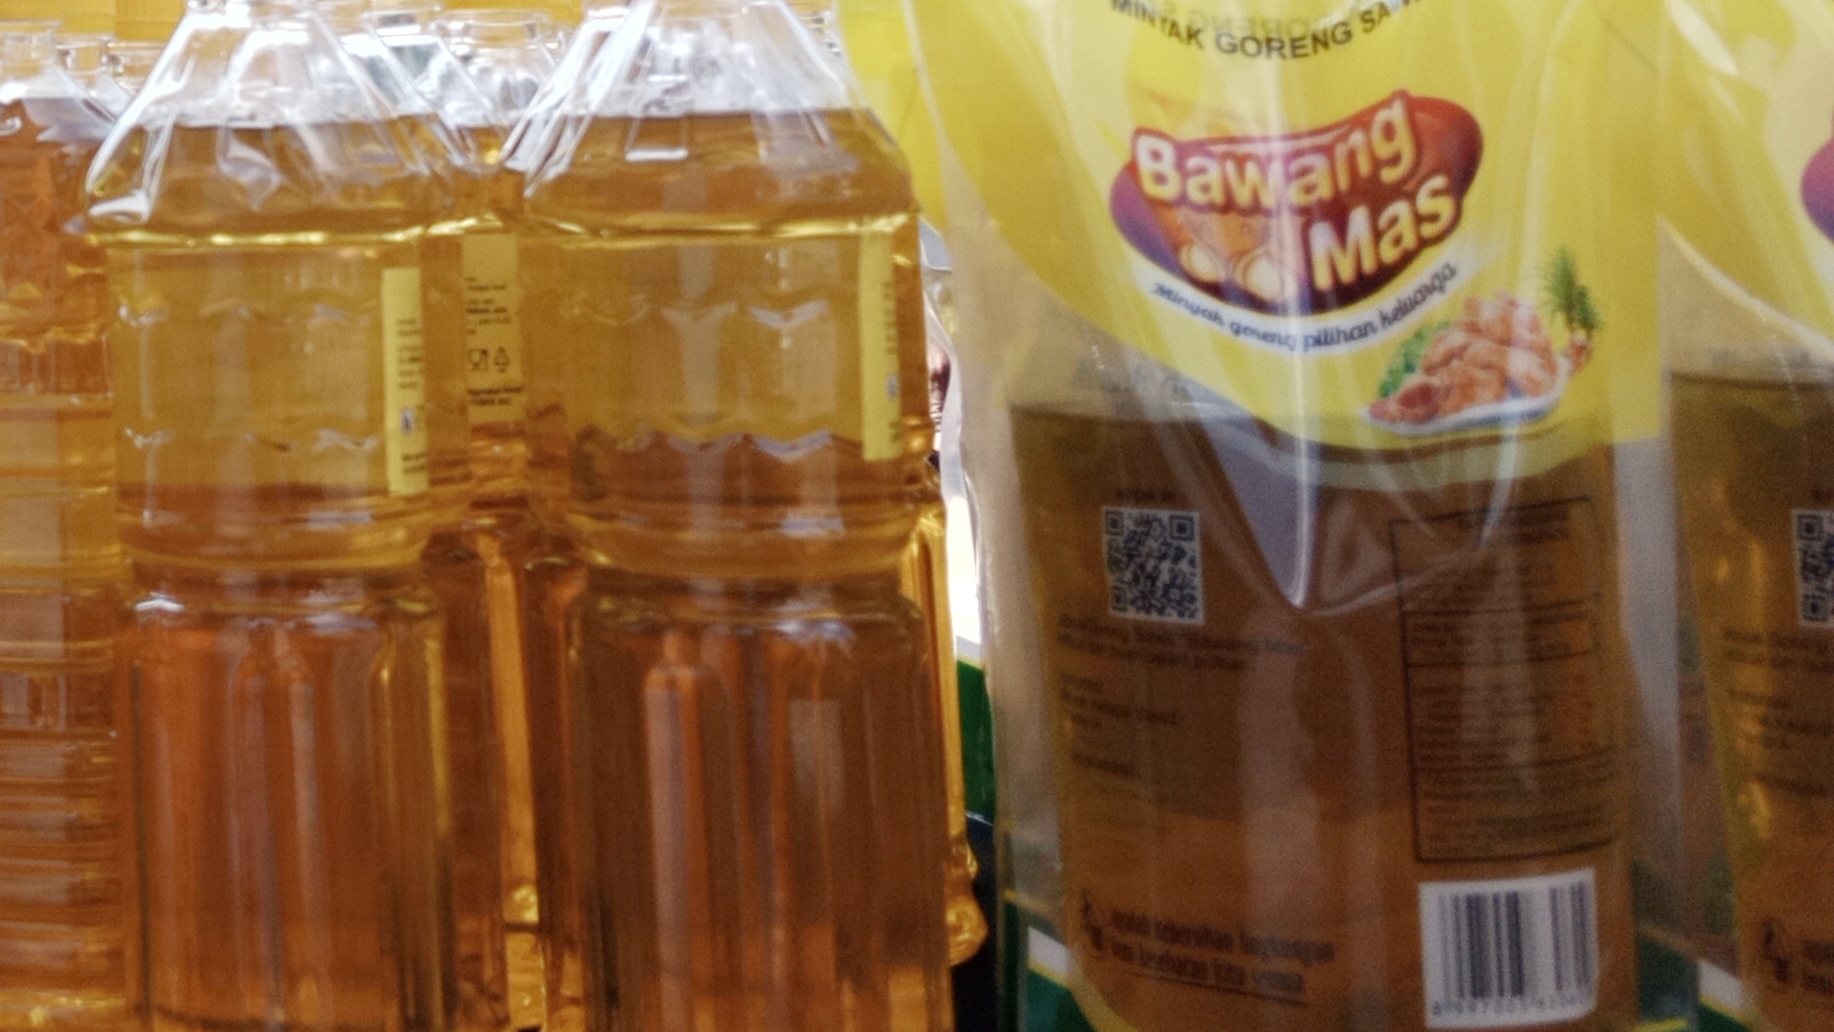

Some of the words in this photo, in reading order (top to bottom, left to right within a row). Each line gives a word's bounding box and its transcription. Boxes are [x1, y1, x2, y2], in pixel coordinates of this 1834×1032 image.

[1215, 20, 1352, 59] GORENG
[1135, 95, 1418, 209] Bawang
[1308, 173, 1456, 293] Mas
[1152, 282, 1225, 325] Minyak
[1229, 318, 1297, 352] goreng
[1303, 318, 1377, 353] pilihan
[1377, 261, 1458, 329] keluarga
